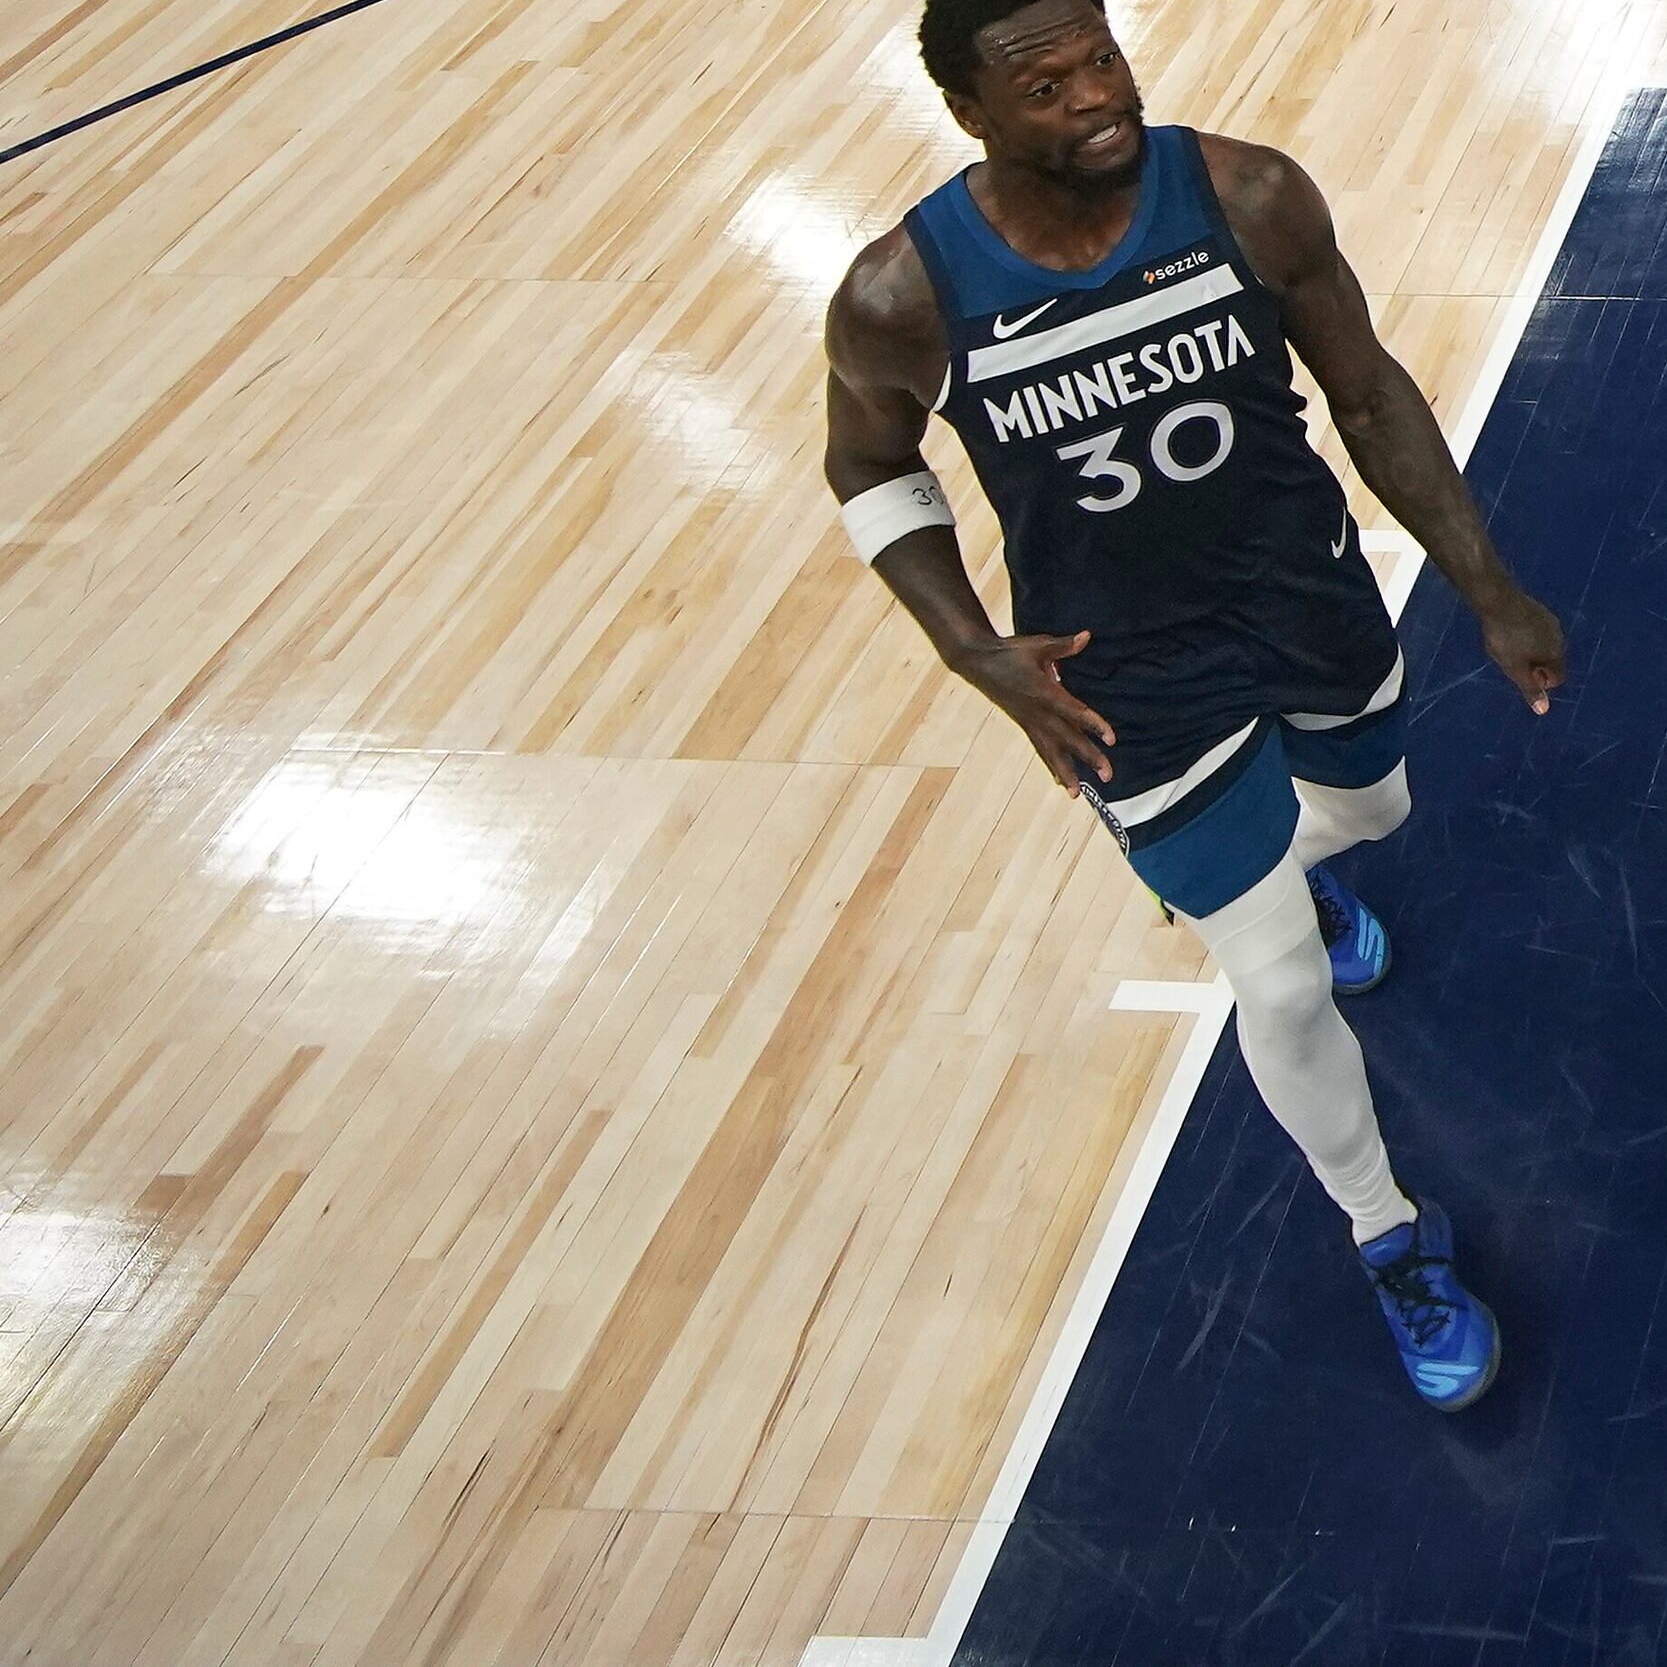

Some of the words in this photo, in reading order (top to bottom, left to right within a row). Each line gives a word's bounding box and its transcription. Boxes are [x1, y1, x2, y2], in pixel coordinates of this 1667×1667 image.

[1154, 249, 1210, 282] sezzle
[982, 314, 1257, 443] MINNESOTA
[1055, 400, 1236, 513] 30
